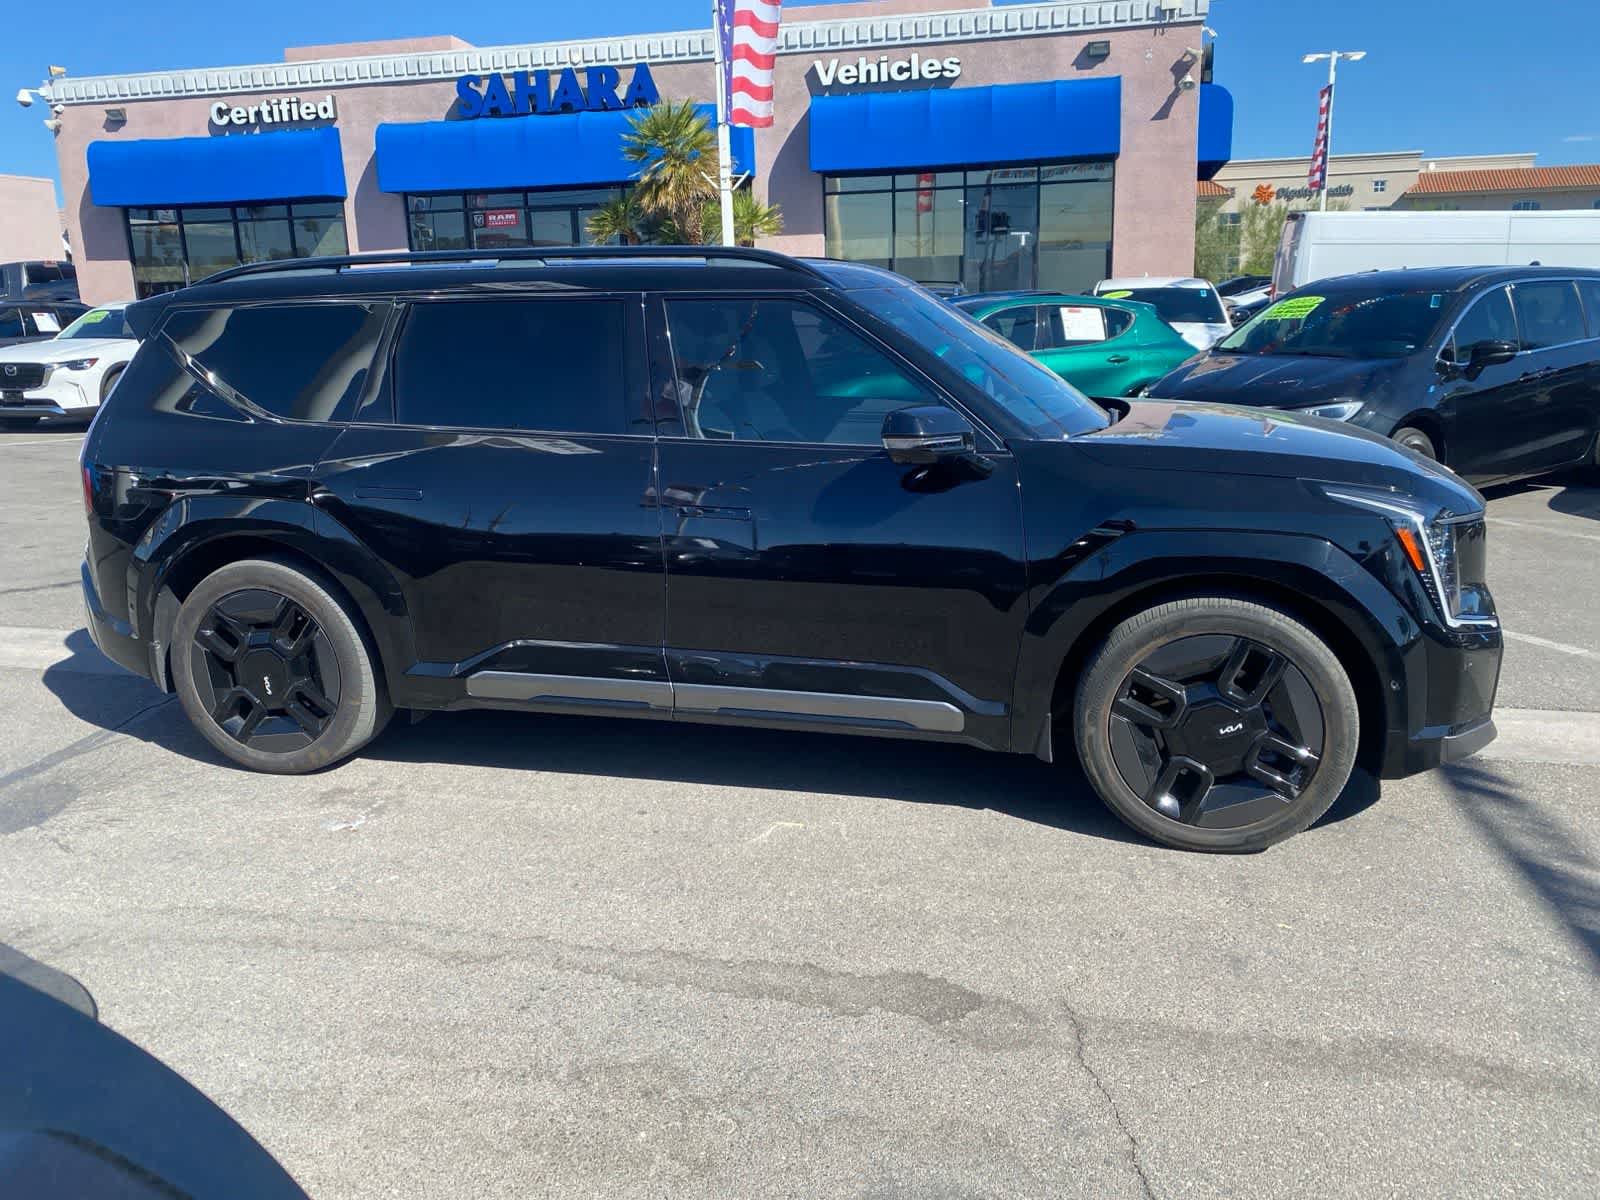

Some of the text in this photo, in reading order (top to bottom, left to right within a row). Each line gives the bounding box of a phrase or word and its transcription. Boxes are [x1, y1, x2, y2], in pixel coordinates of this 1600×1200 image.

[814, 53, 961, 86] Vehicles
[456, 62, 661, 117] SAHARA
[210, 94, 336, 125] Certified
[488, 213, 516, 222] RAM
